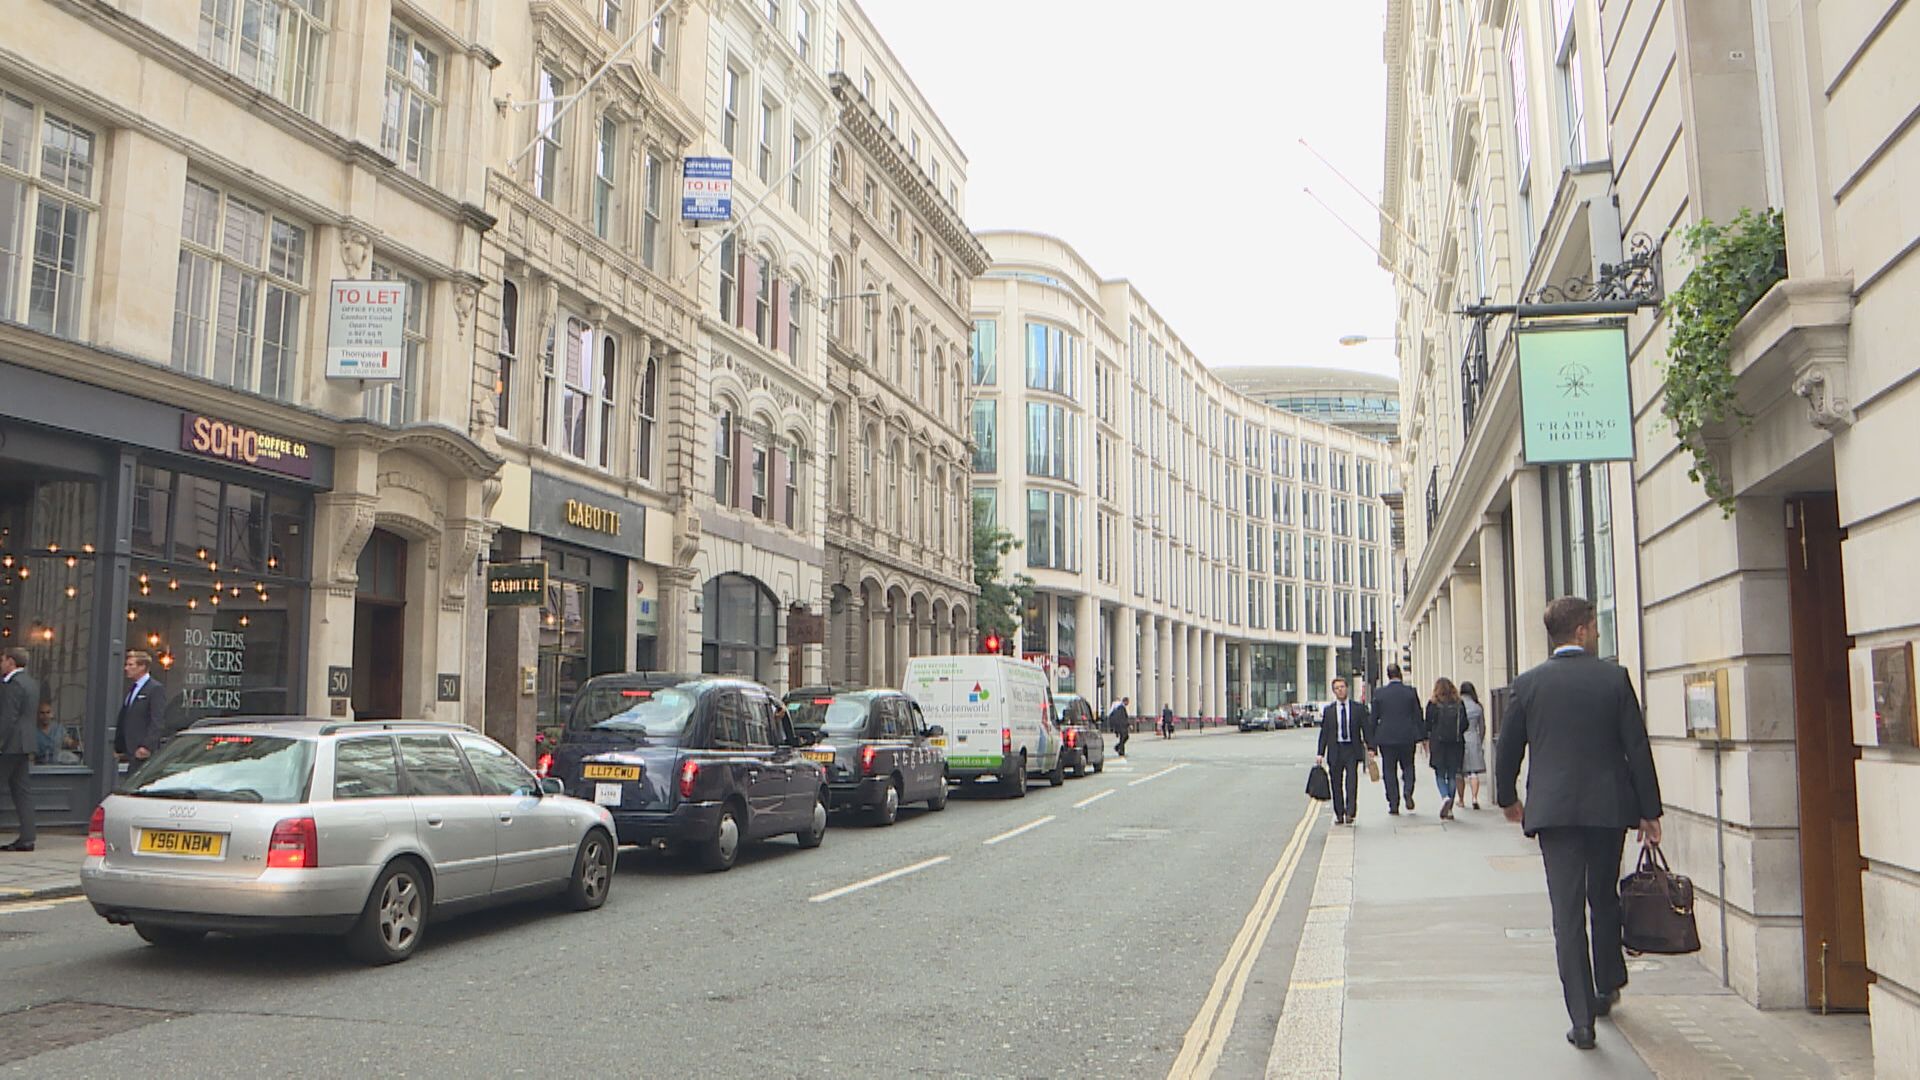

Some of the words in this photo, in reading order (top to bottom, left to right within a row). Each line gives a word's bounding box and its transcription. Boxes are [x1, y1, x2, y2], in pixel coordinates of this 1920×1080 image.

[687, 181, 704, 190] TO
[707, 181, 729, 192] LET
[336, 289, 361, 304] TO
[366, 289, 401, 305] LET
[341, 350, 382, 359] Thompson
[360, 360, 381, 368] Yates
[1536, 419, 1616, 431] TRADING
[192, 416, 259, 464] SOHO
[258, 434, 291, 455] COFFEE
[293, 443, 309, 459] CO.
[1549, 430, 1607, 441] HOUSE
[567, 498, 622, 537] CABOTTE
[491, 578, 541, 593] CABOTTE
[331, 671, 348, 692] 50
[442, 679, 456, 696] 50
[941, 703, 990, 713] Greenworld
[590, 766, 612, 777] LL17
[614, 767, 634, 778] CWU
[150, 832, 179, 849] Y961
[181, 834, 212, 852] NBM
